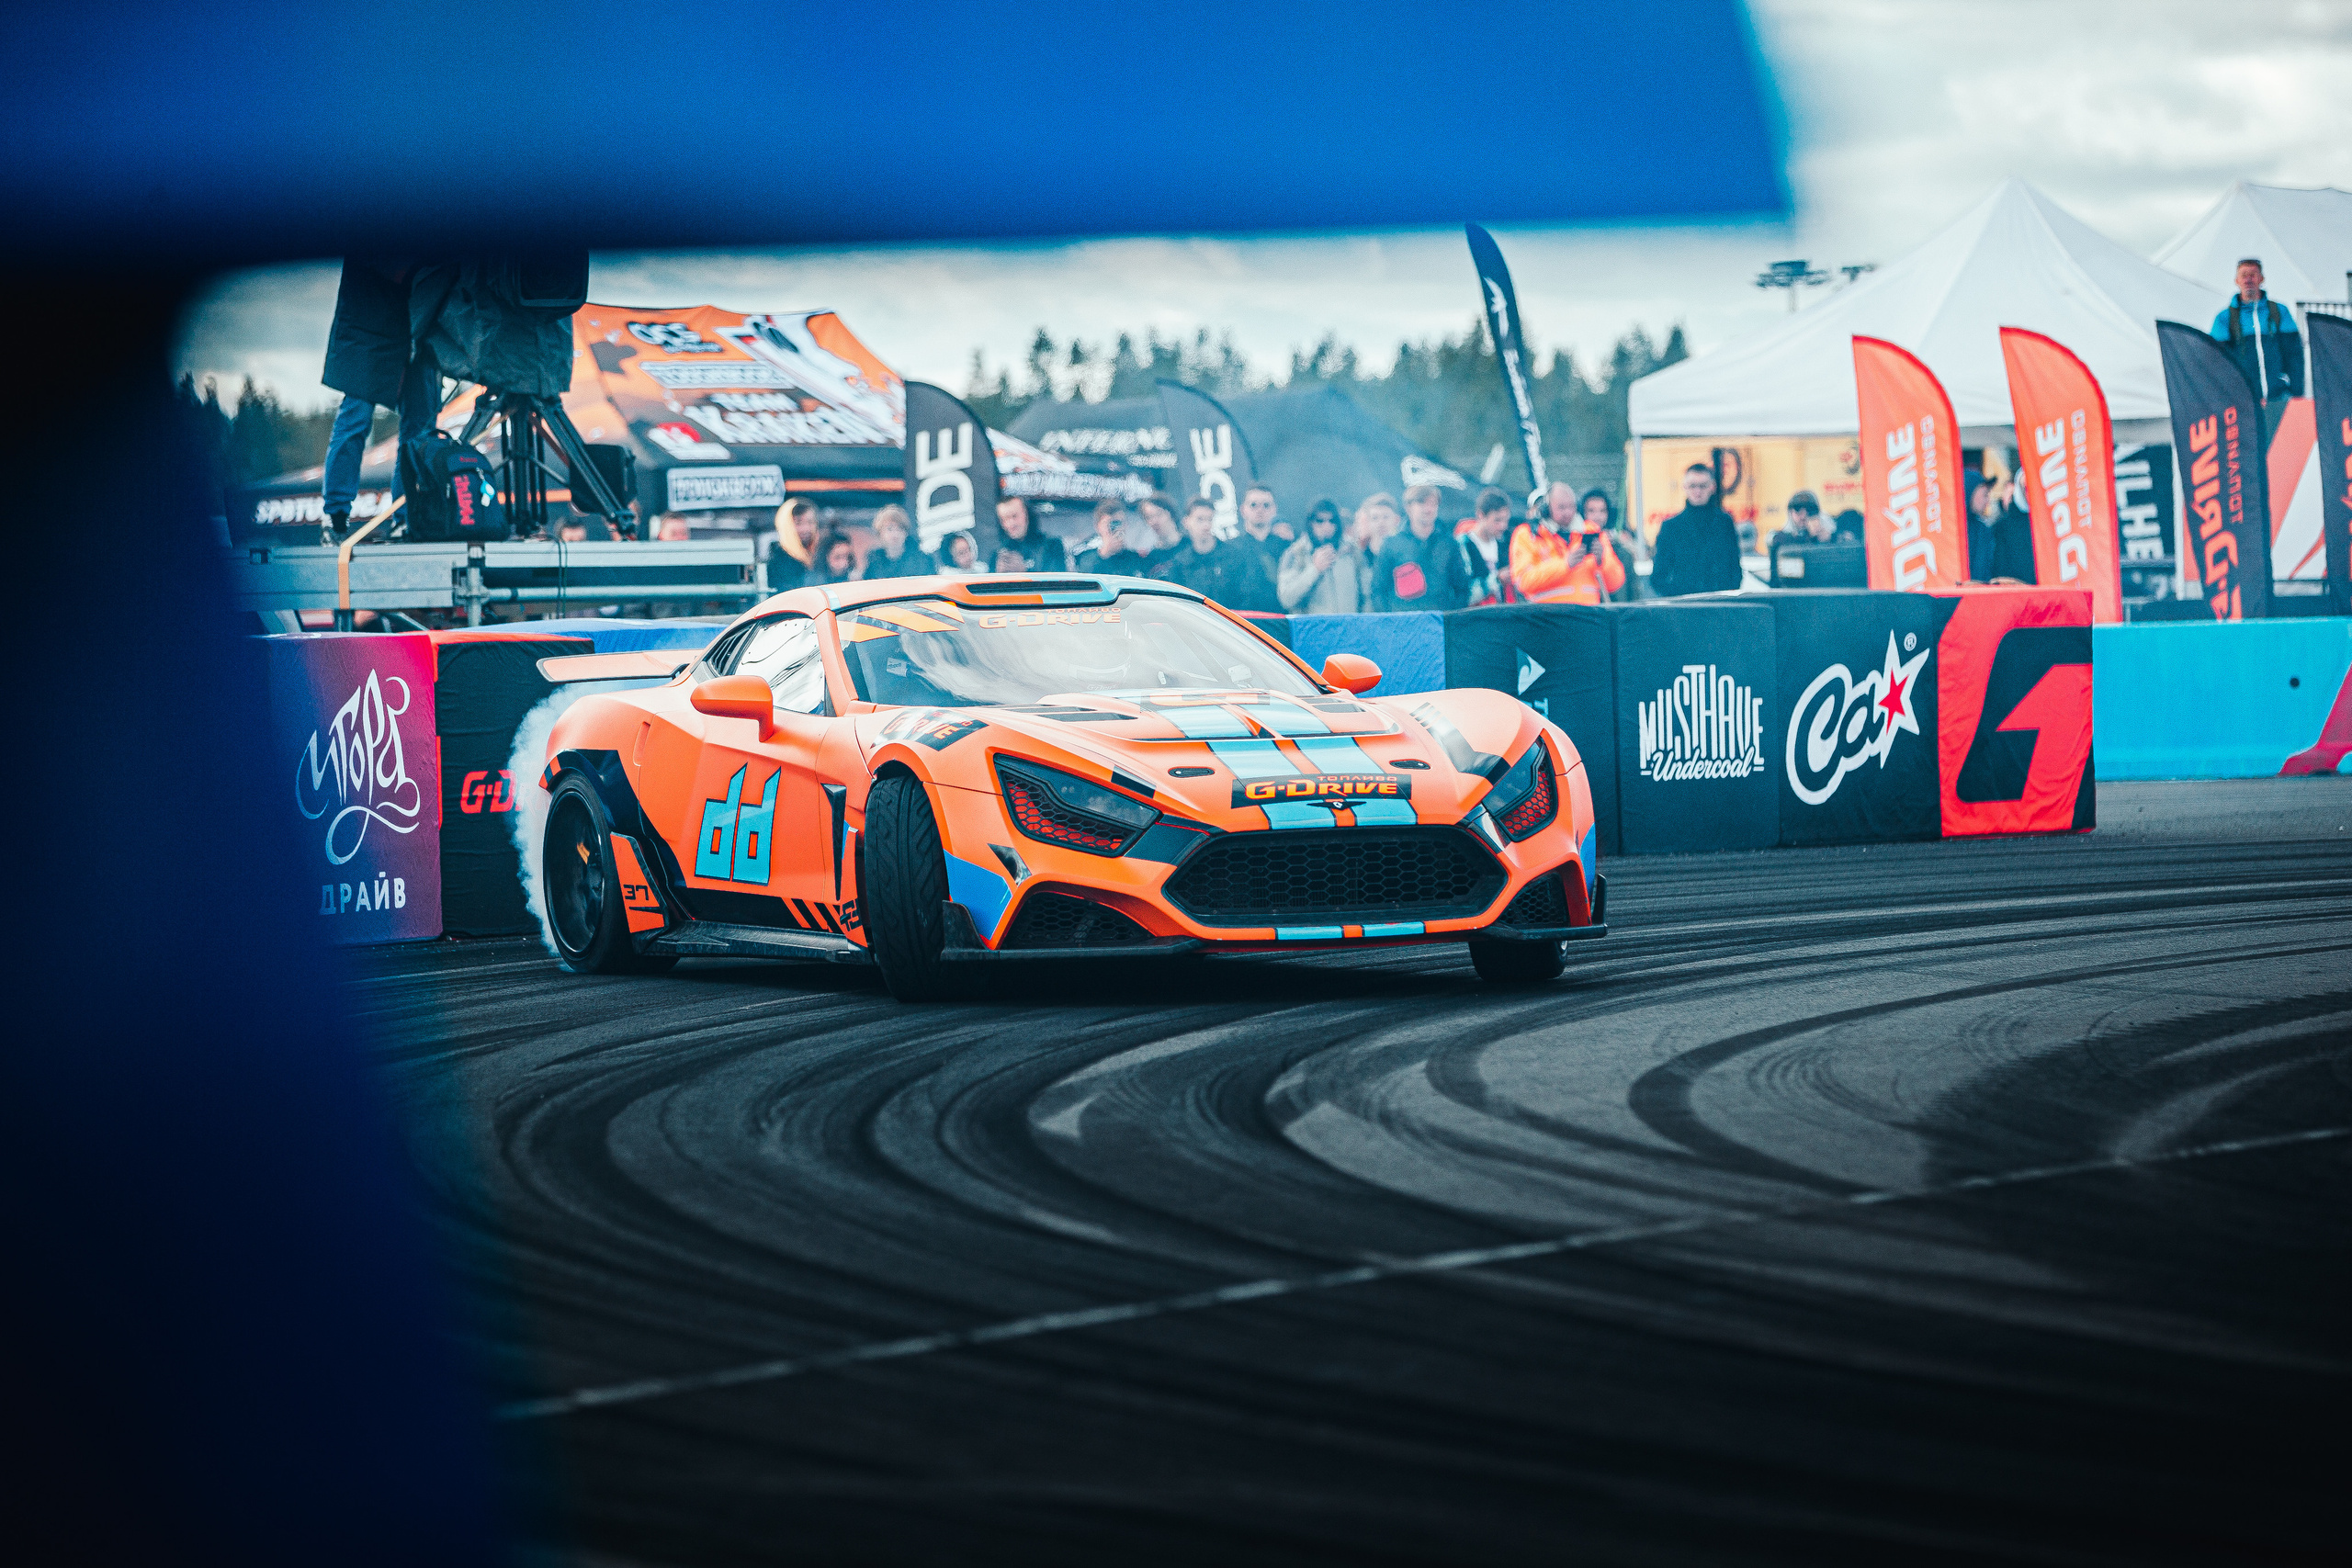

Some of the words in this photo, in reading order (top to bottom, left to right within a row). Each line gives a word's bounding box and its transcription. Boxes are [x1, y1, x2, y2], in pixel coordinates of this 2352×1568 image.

[978, 611, 1121, 629] G-DRIVE
[1651, 746, 1755, 781] Undercoal
[1245, 779, 1397, 800] G-DRIVE
[319, 872, 406, 916] ДРАЙВ
